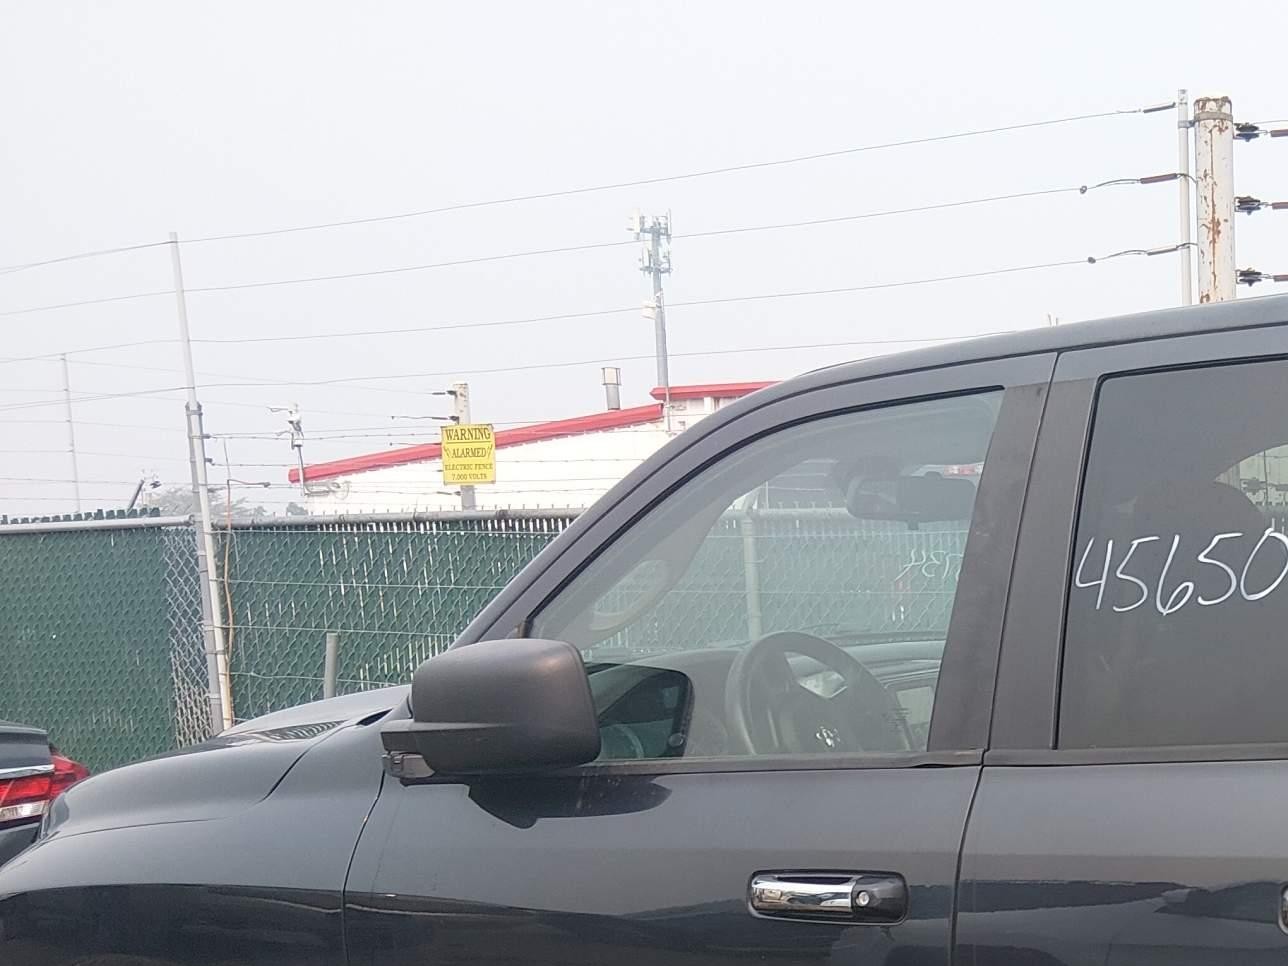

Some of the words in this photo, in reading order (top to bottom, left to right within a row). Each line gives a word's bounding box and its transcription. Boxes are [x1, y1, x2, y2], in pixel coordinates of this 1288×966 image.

[445, 428, 491, 441] WARNING
[452, 447, 487, 458] ALARMED
[445, 463, 472, 471] ELECTRIC
